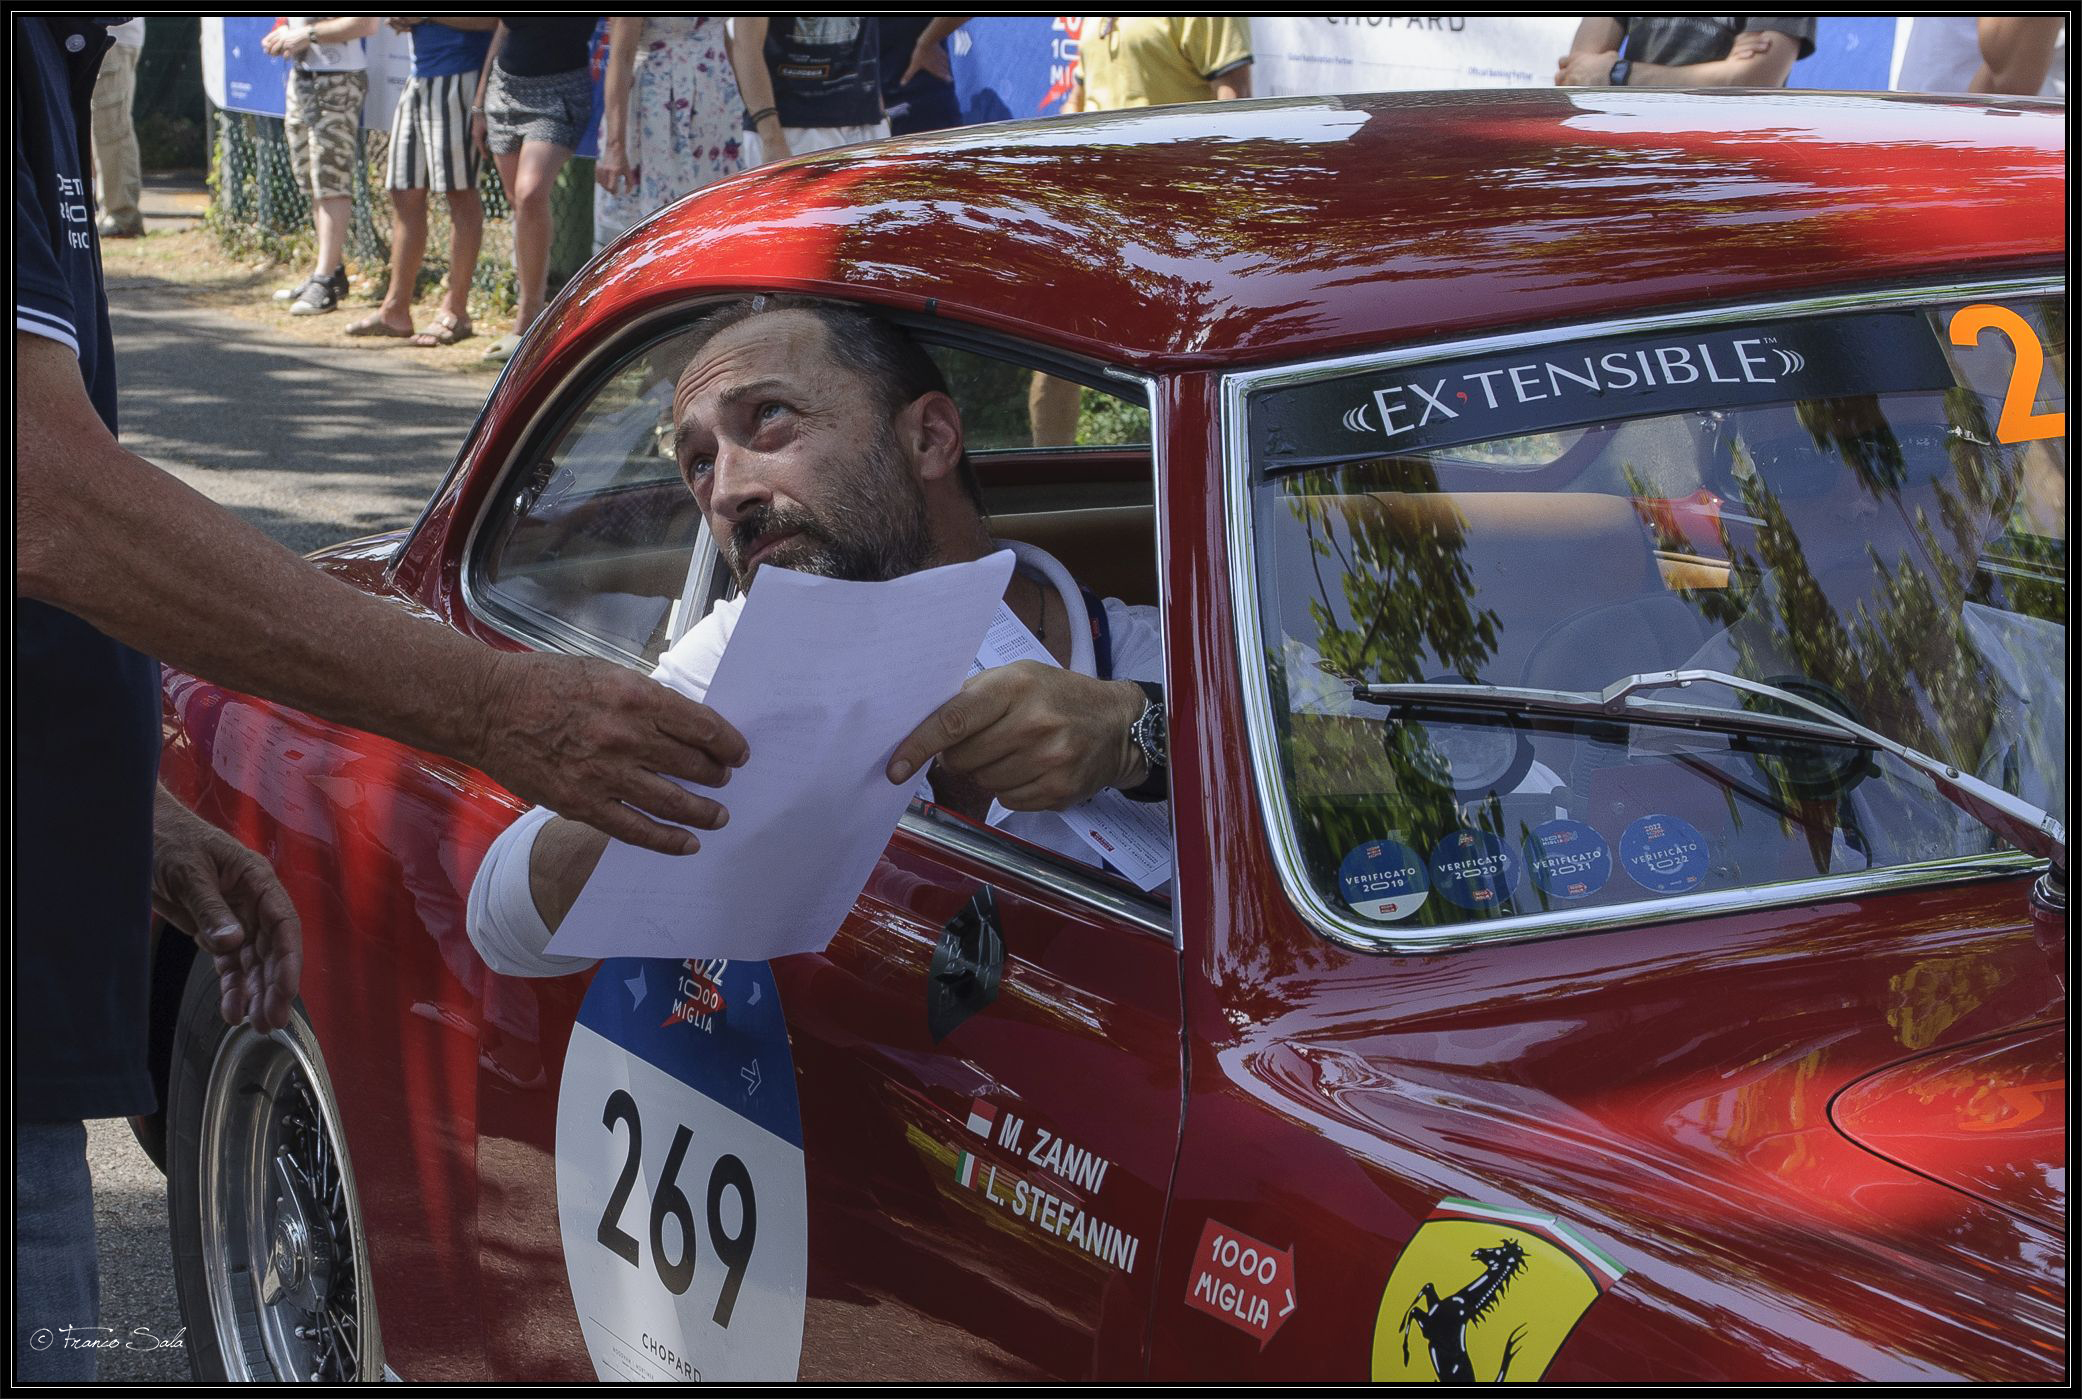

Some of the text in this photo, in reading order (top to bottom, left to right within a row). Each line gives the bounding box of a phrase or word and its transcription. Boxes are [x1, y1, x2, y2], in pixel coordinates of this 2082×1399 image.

[1949, 304, 2065, 444] 2
[1438, 854, 1507, 872] VERIFICATO
[1533, 850, 1601, 870] VERIFICATO
[1550, 862, 1591, 877] 2021
[1631, 843, 1697, 865] VERIFICATO
[1648, 855, 1689, 871] 2022
[1345, 867, 1416, 885] VERIFICATO
[1362, 879, 1404, 893] 2019
[1454, 865, 1497, 880] 2020
[678, 976, 719, 1009] 1000
[672, 998, 712, 1034] MIGLIA
[998, 1113, 1109, 1195] M. ZANNI
[597, 1089, 757, 1329] 269
[986, 1166, 1139, 1274] L. STEFANINI
[1212, 1235, 1277, 1285] 1000
[1194, 1271, 1269, 1329] MIGLIA
[641, 1333, 702, 1383] CHOPARD
